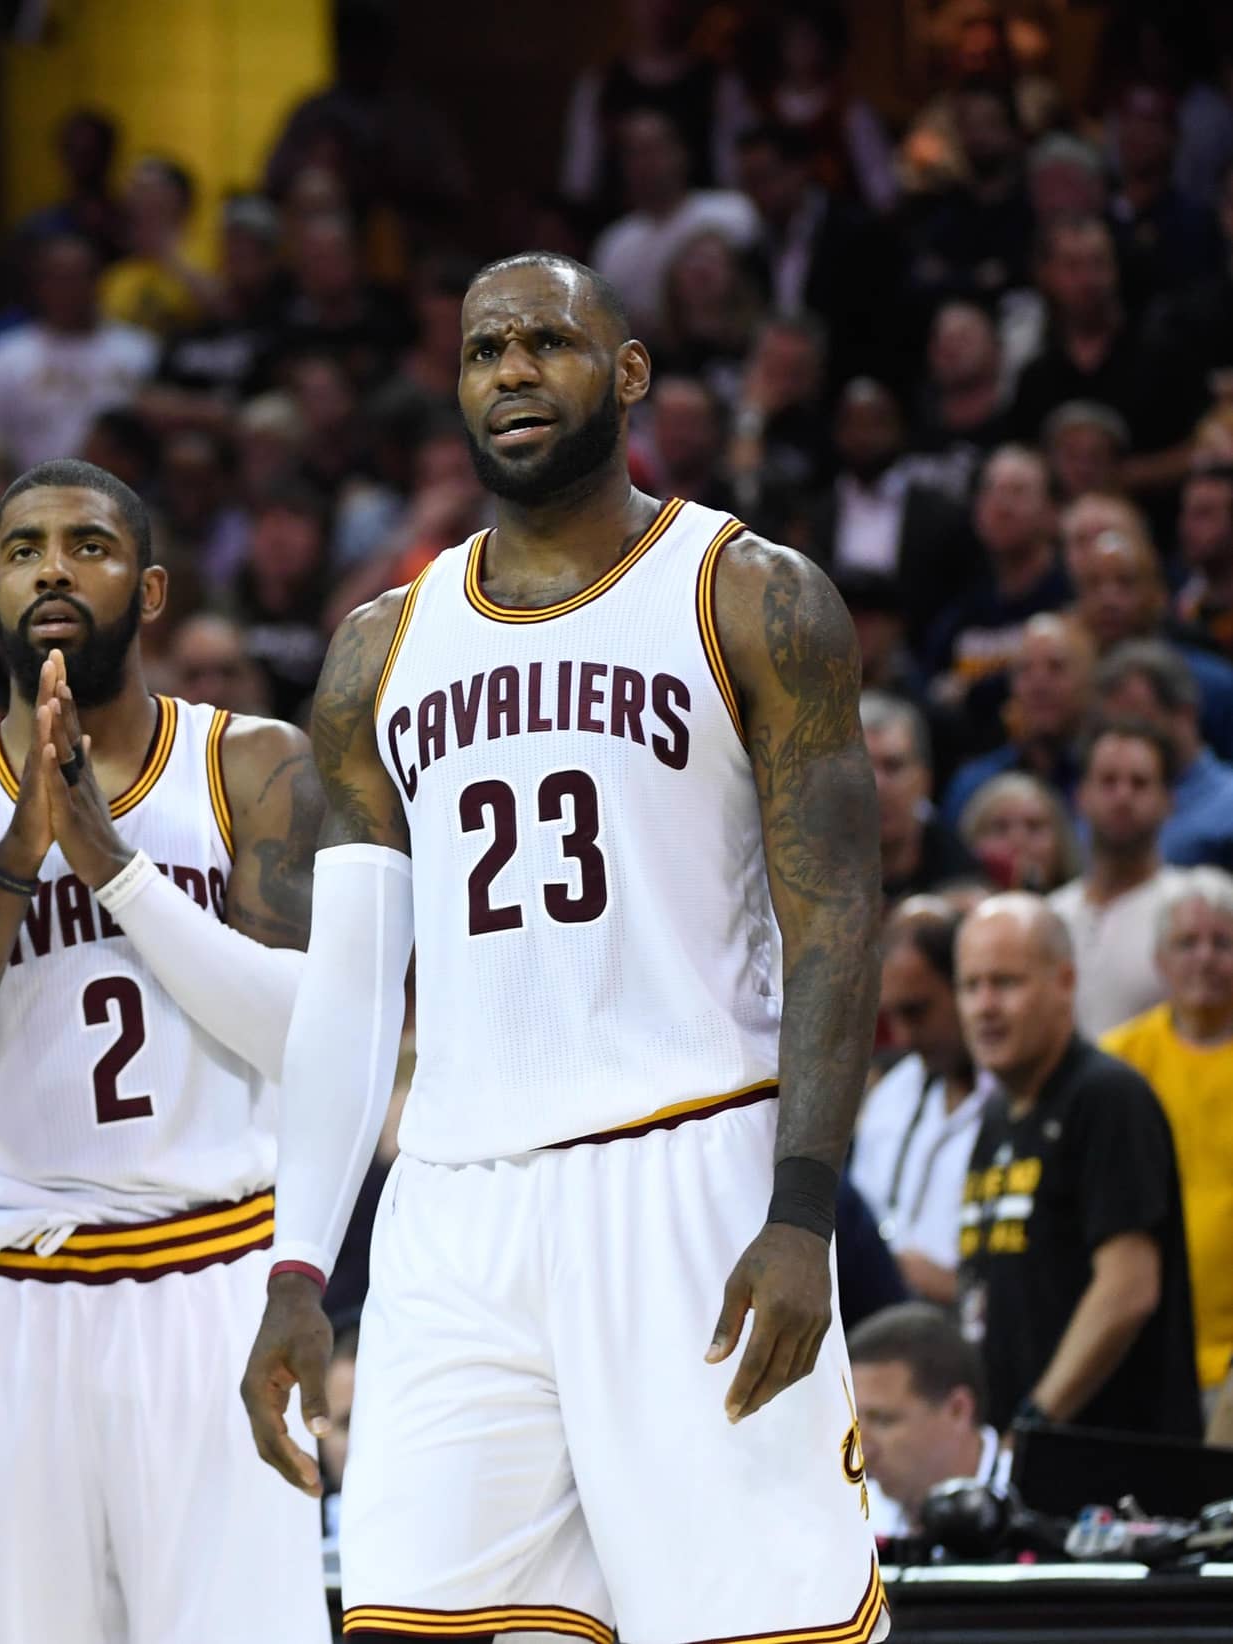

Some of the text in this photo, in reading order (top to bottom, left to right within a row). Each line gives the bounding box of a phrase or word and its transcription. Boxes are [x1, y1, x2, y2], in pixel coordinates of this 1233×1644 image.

[387, 660, 691, 803] CAVALIERS
[458, 768, 608, 937] 23
[82, 976, 154, 1125] 2
